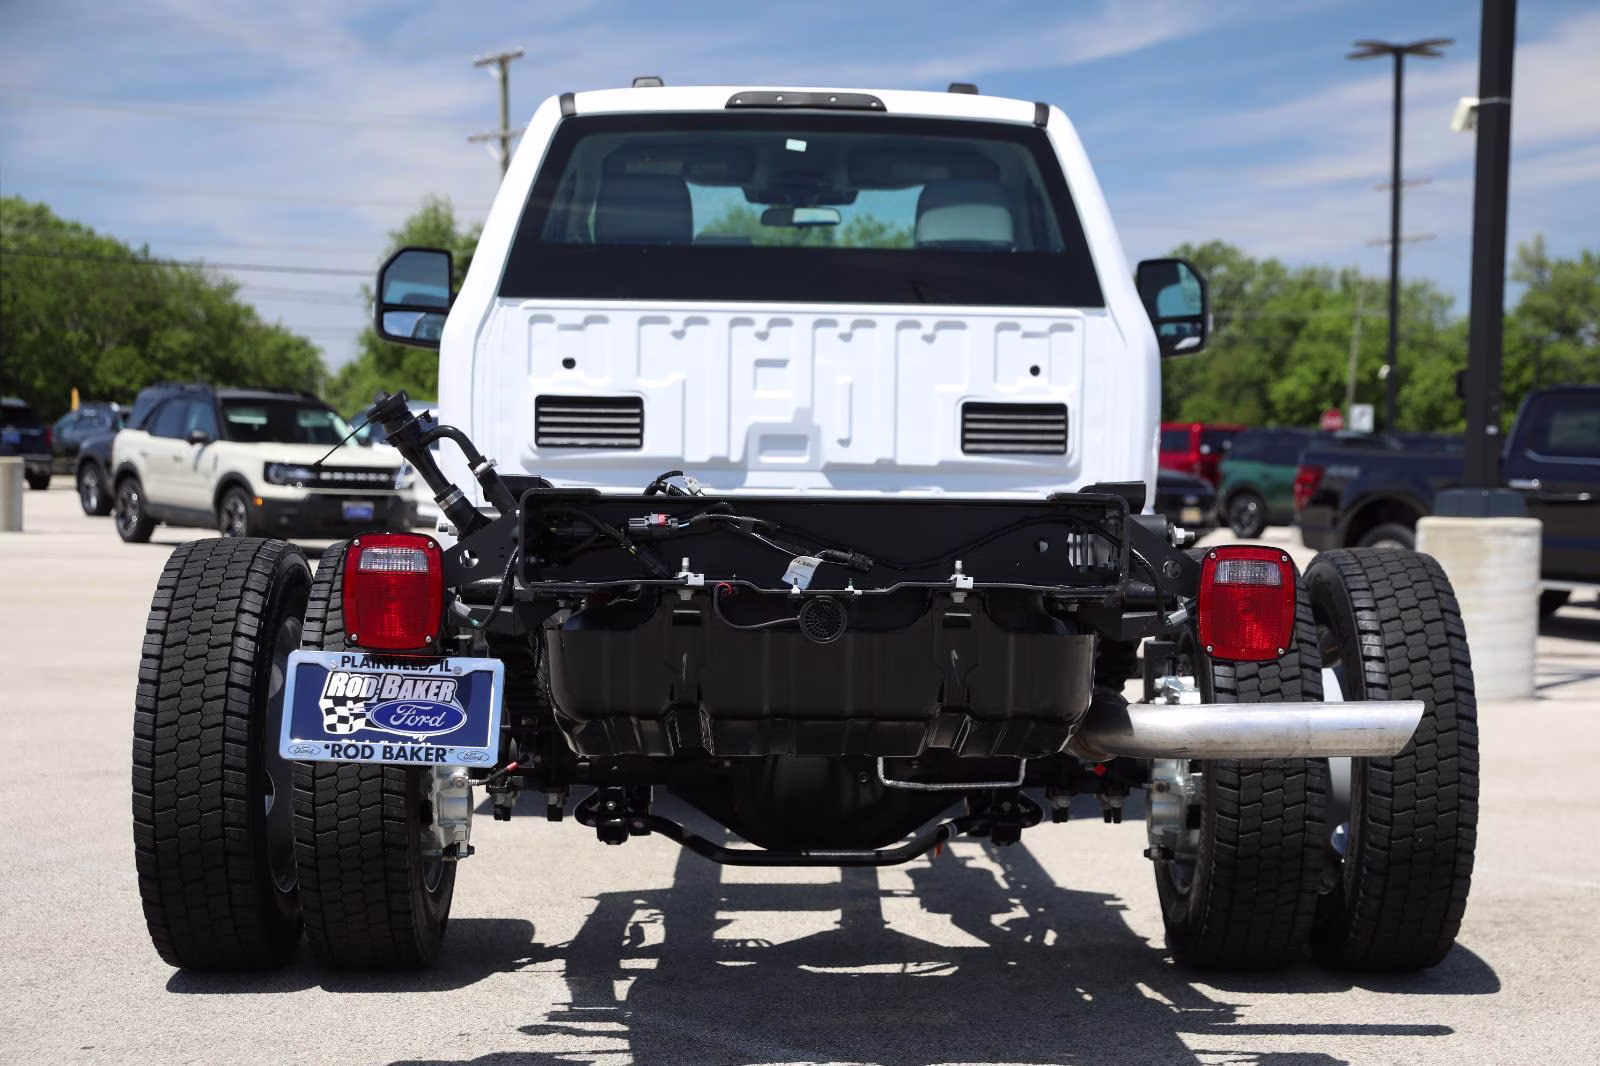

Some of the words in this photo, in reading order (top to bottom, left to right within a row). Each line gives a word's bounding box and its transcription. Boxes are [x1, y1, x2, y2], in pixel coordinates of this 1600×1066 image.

[325, 671, 378, 698] ROD
[380, 673, 457, 702] BAKER
[390, 704, 447, 727] Ford
[294, 745, 315, 755] Ford
[330, 743, 375, 760] ROD
[382, 745, 447, 763] BAKER
[463, 752, 484, 761] Ford
